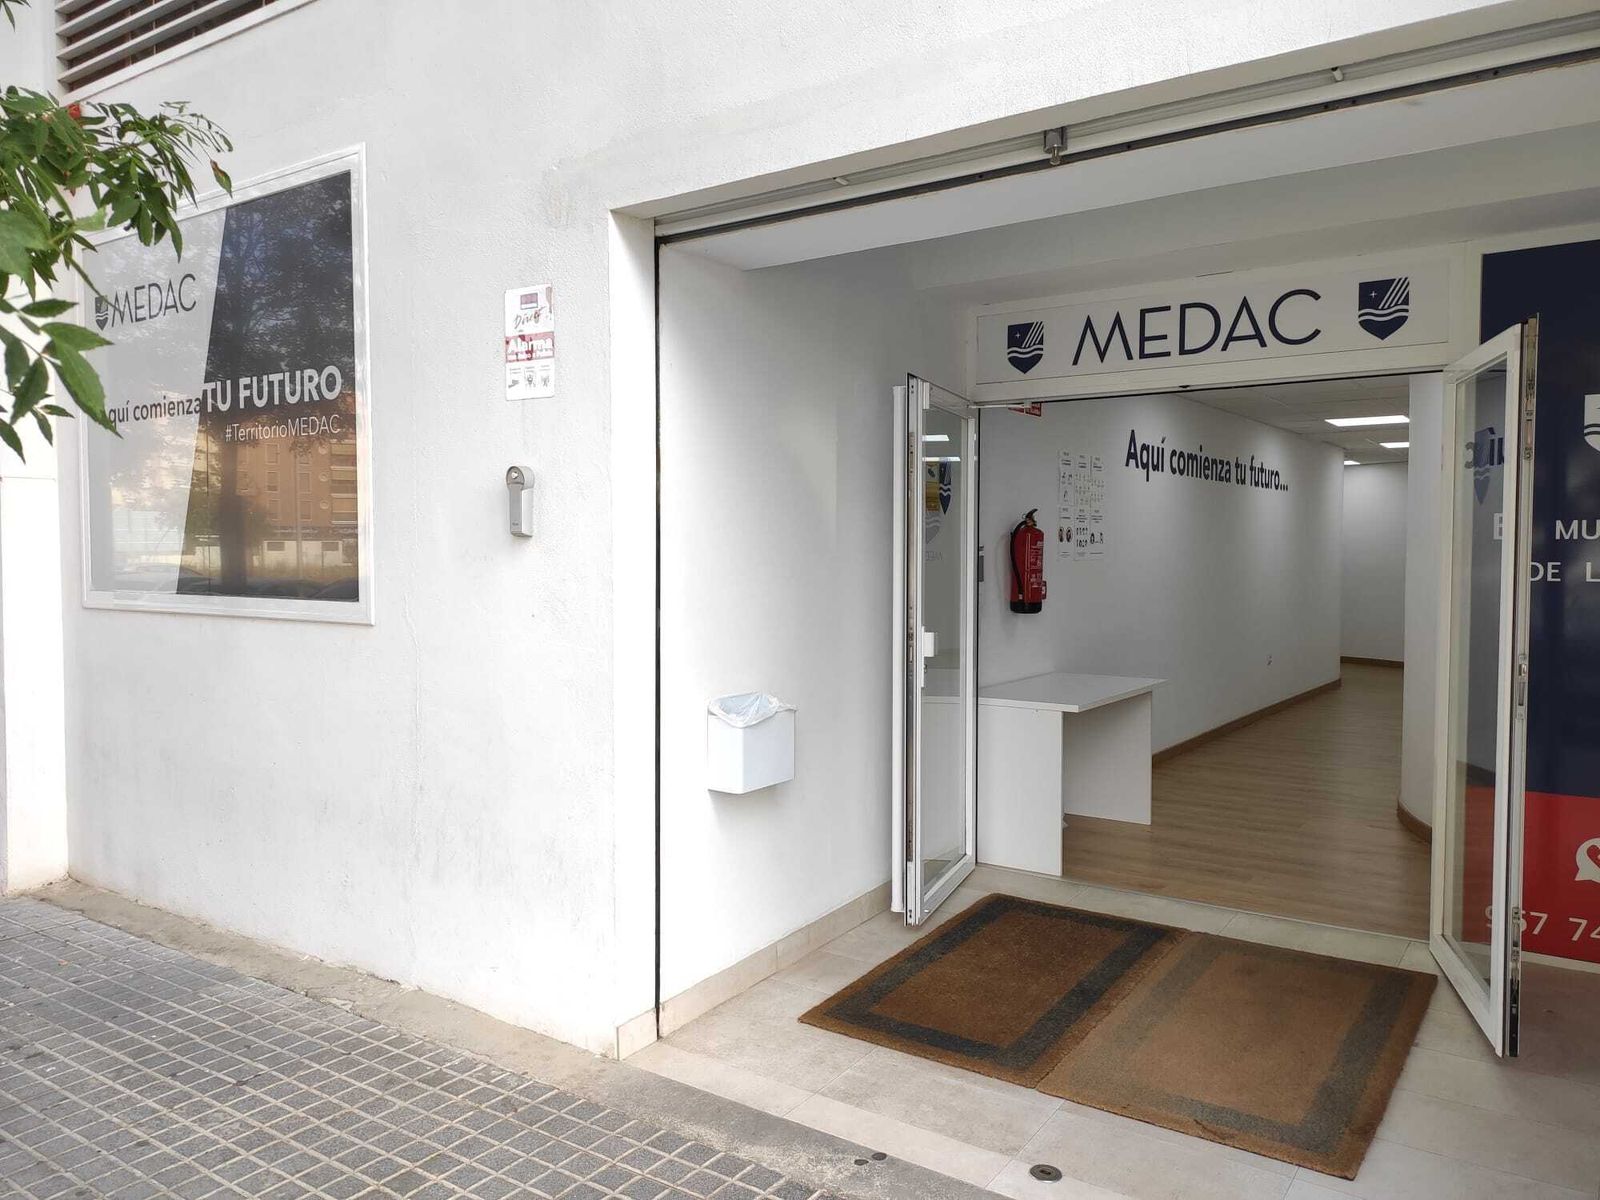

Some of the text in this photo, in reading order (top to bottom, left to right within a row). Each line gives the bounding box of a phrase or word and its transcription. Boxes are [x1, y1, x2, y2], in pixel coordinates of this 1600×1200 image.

[112, 273, 197, 328] MEDAC
[1071, 289, 1321, 366] MEDAC
[108, 365, 342, 430] quí comienza TU FUTURO
[225, 414, 341, 442] #TerritorioMEDAC
[1125, 429, 1289, 492] Aquí comienza tu futuro...
[1529, 561, 1562, 582] DE
